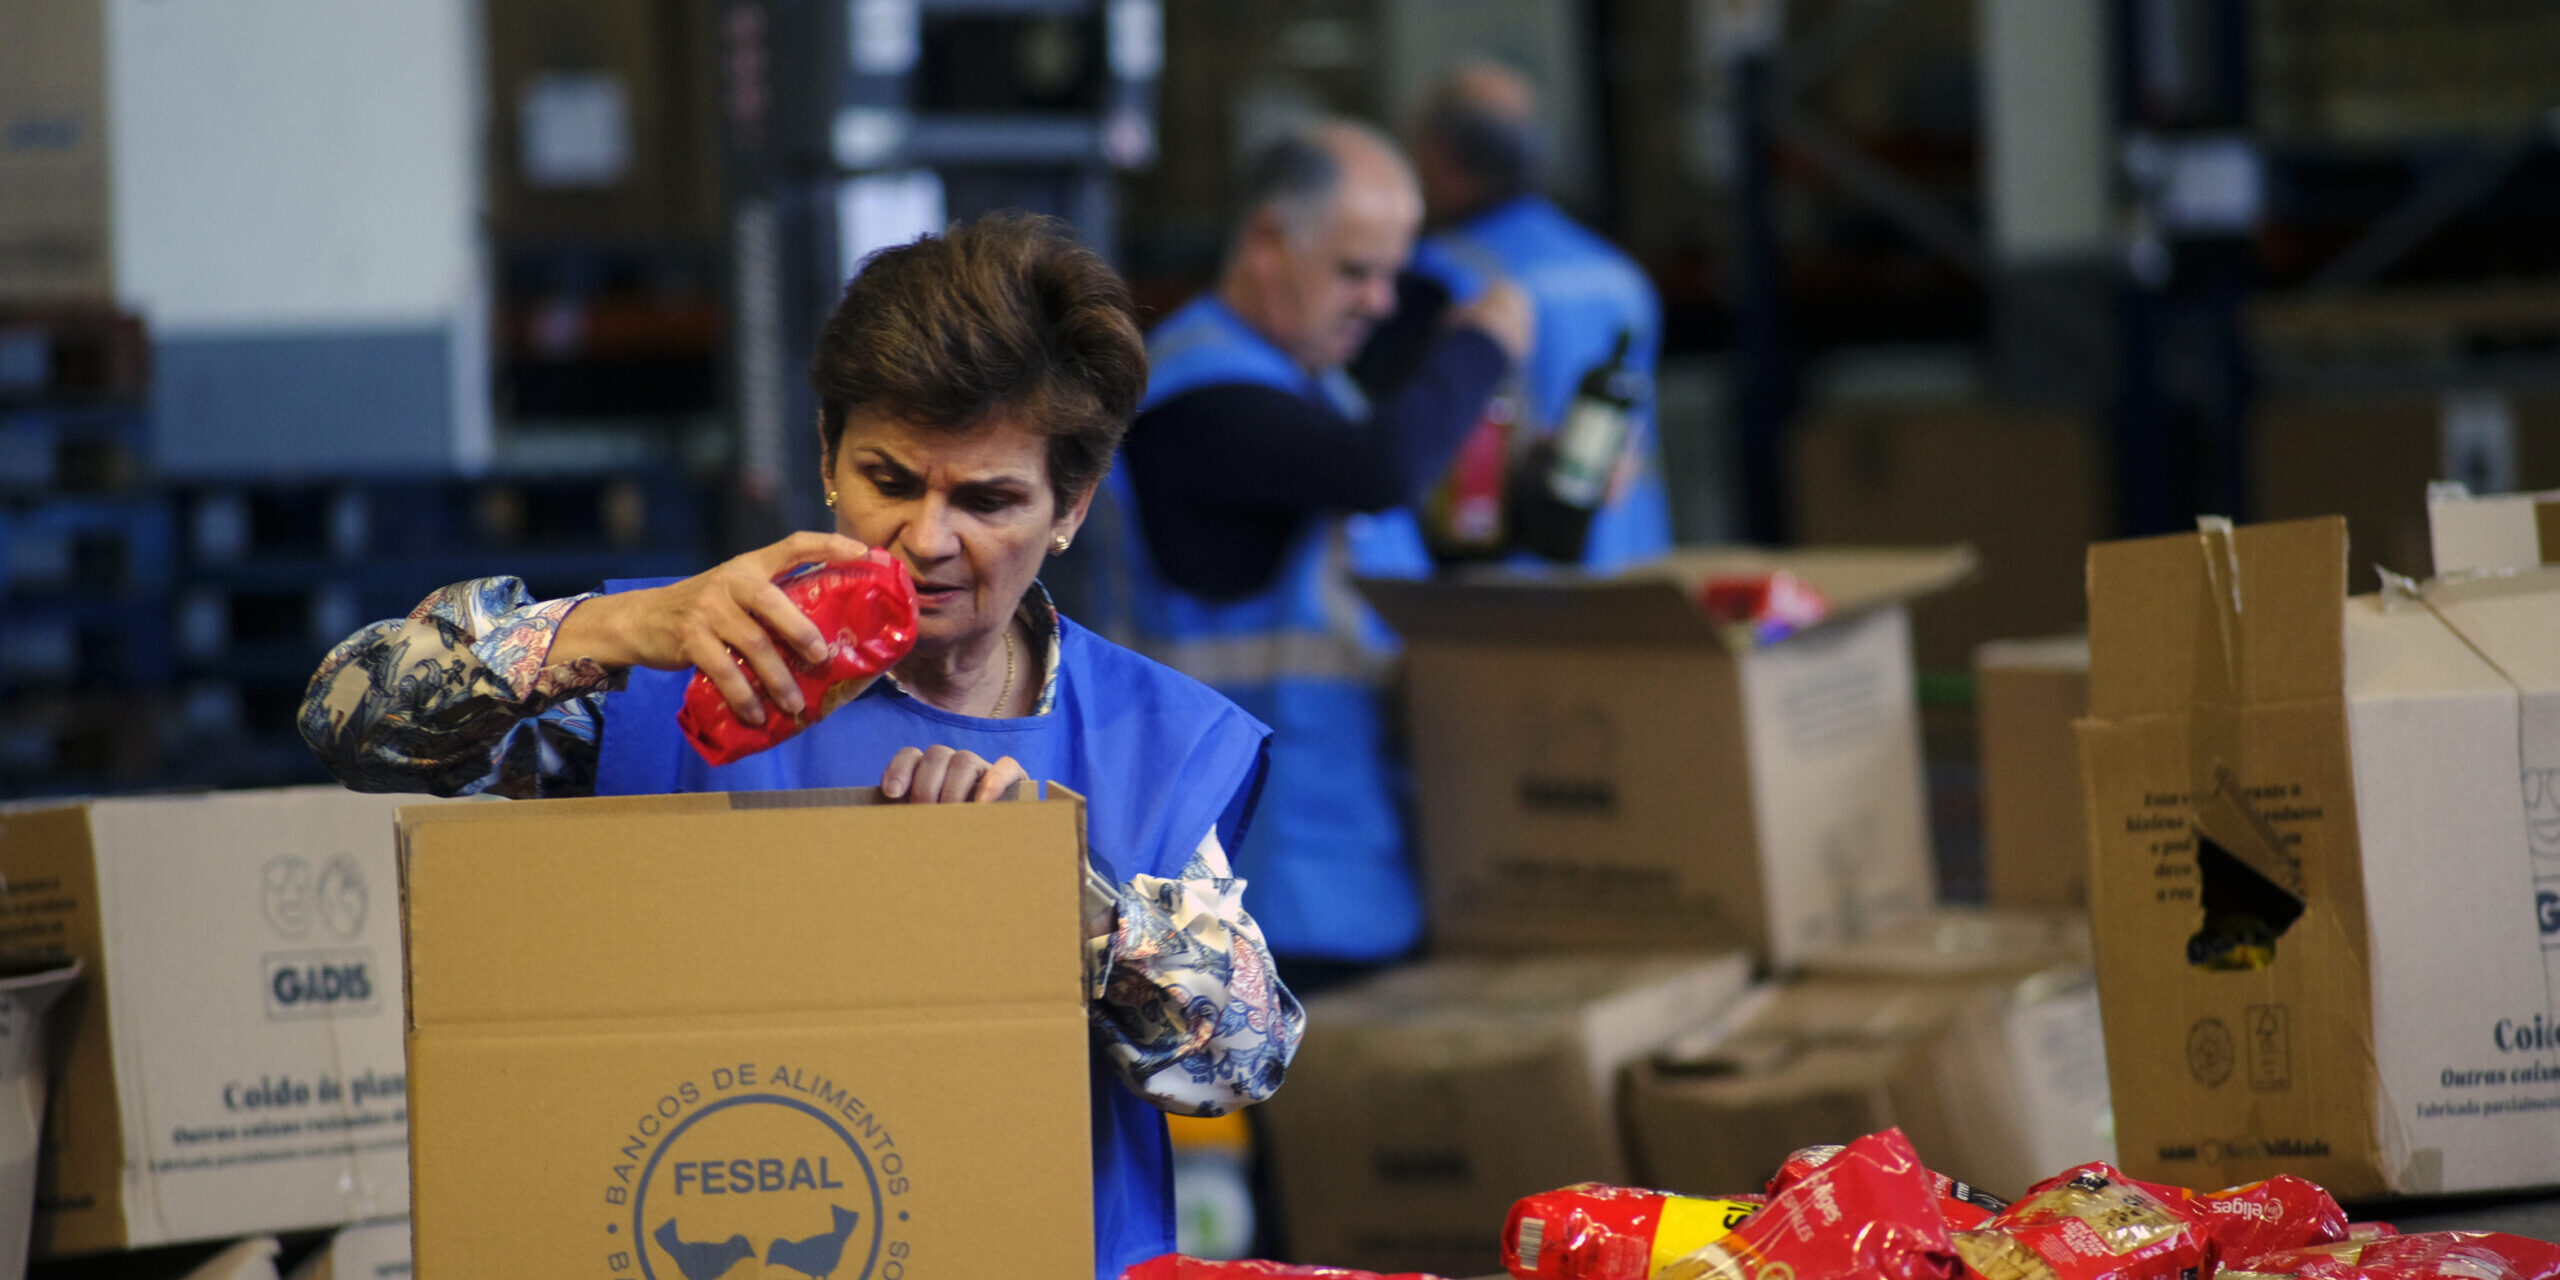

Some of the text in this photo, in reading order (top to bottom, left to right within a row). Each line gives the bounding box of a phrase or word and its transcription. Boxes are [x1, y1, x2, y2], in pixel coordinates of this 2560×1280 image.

[273, 963, 371, 1005] GADIS
[606, 1063, 910, 1205] BANCOS DE ALIMENTOS
[674, 1156, 844, 1195] FESBAL
[2212, 1197, 2263, 1221] eliges
